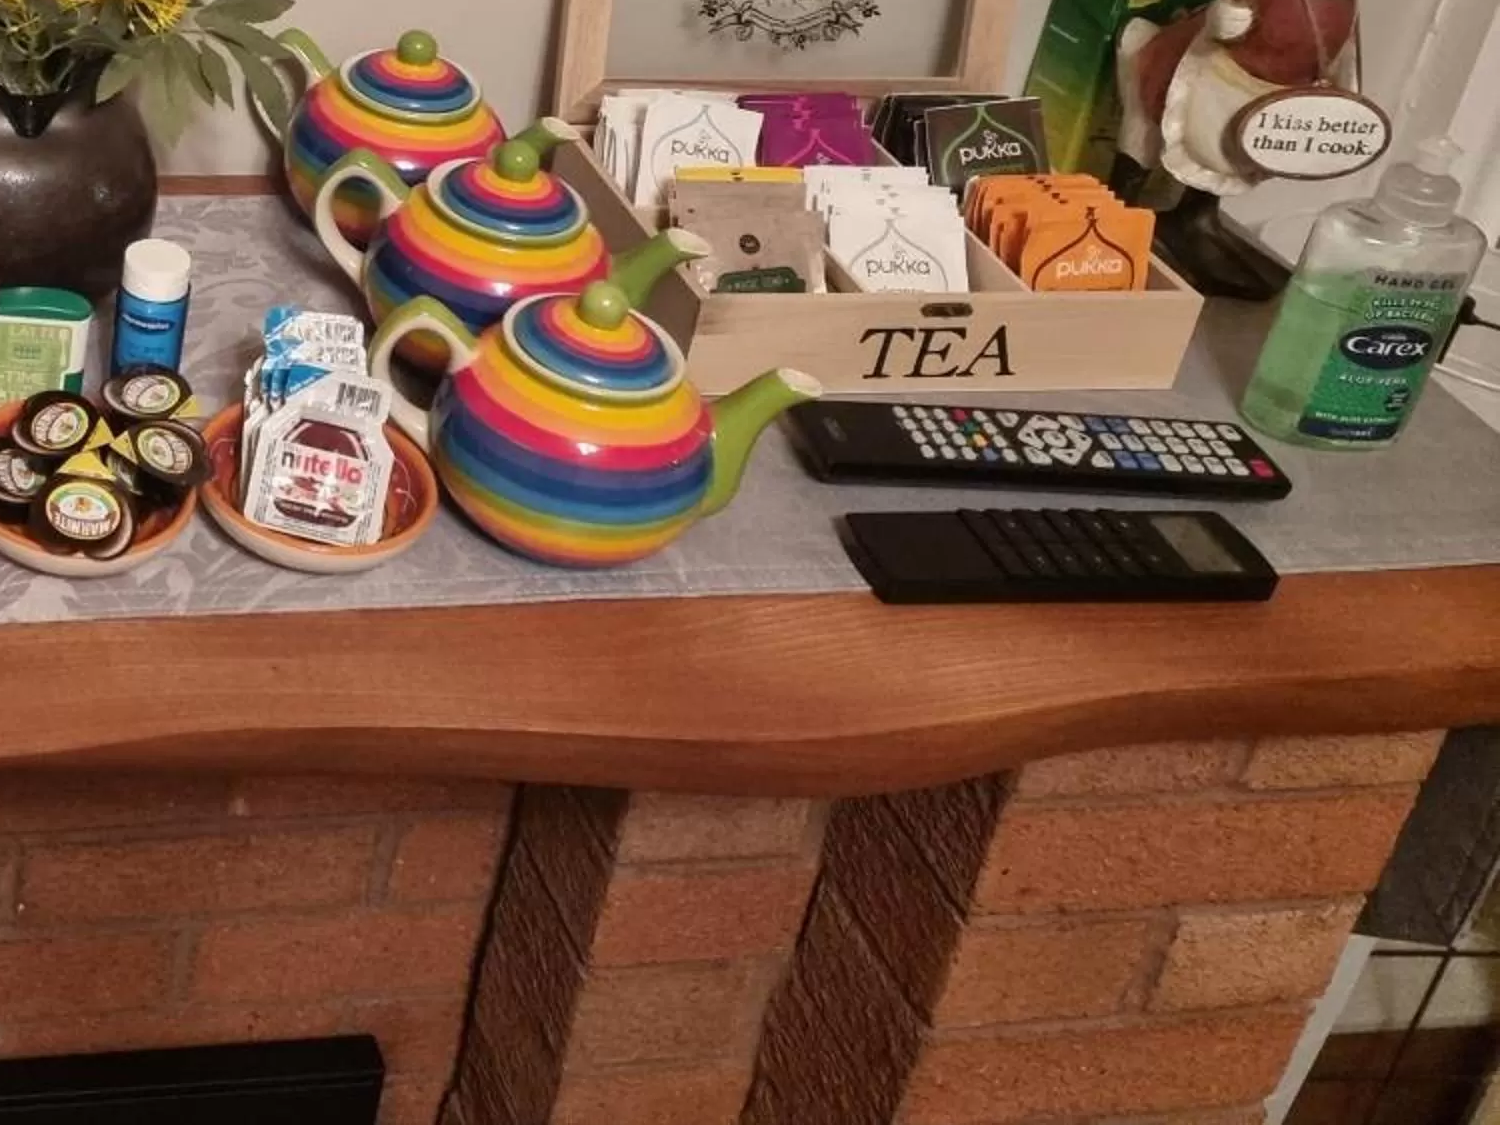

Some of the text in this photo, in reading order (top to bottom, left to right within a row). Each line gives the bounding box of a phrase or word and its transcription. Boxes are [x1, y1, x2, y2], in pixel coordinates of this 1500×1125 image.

[1258, 112, 1379, 135] I kiss better
[670, 138, 731, 164] pukka
[959, 139, 1023, 165] pukka
[1253, 135, 1374, 156] than I cook.
[865, 255, 931, 277] pukka
[1056, 255, 1124, 279] pukka
[1373, 274, 1426, 291] HAND
[859, 325, 1017, 379] TEA
[1346, 335, 1429, 357] Carex
